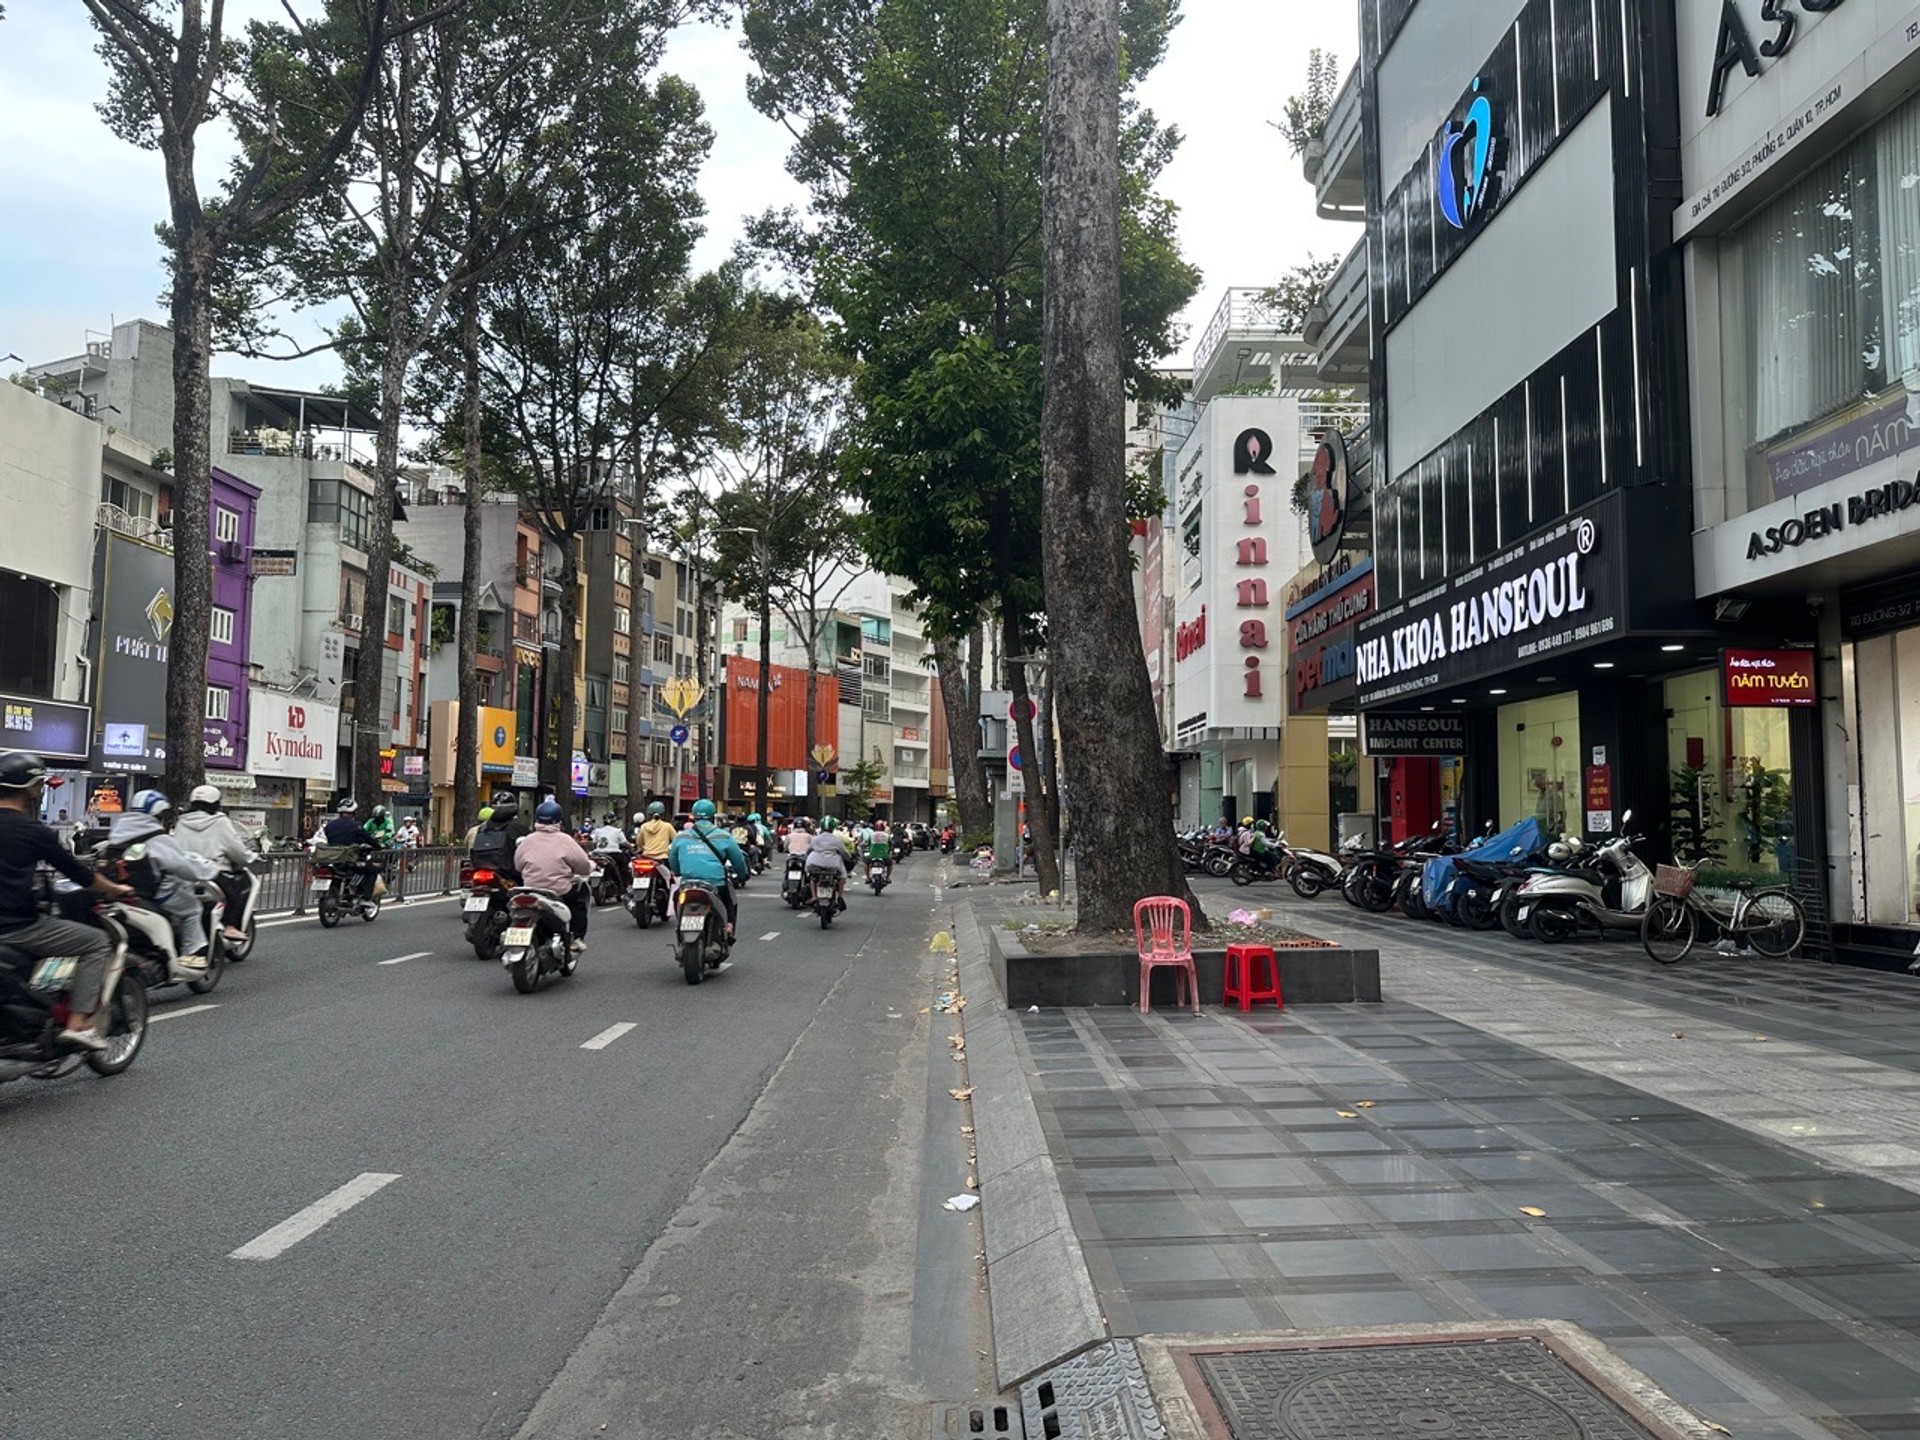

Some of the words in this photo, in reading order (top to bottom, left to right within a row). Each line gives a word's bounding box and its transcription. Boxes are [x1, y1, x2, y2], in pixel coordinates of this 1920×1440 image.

[1706, 0, 1846, 117] AS
[1746, 503, 1843, 560] ASOEN
[1234, 428, 1277, 697] Rinnai
[1356, 635, 1391, 686] NHA
[1392, 612, 1447, 674] KHOA
[1451, 551, 1586, 654] HANSEOUL
[1731, 673, 1764, 687] NĂM
[265, 730, 323, 761] Kymdan
[1369, 718, 1463, 732] HANSEOUL
[1369, 738, 1419, 749] IMPLANT
[1422, 737, 1464, 749] CENTER
